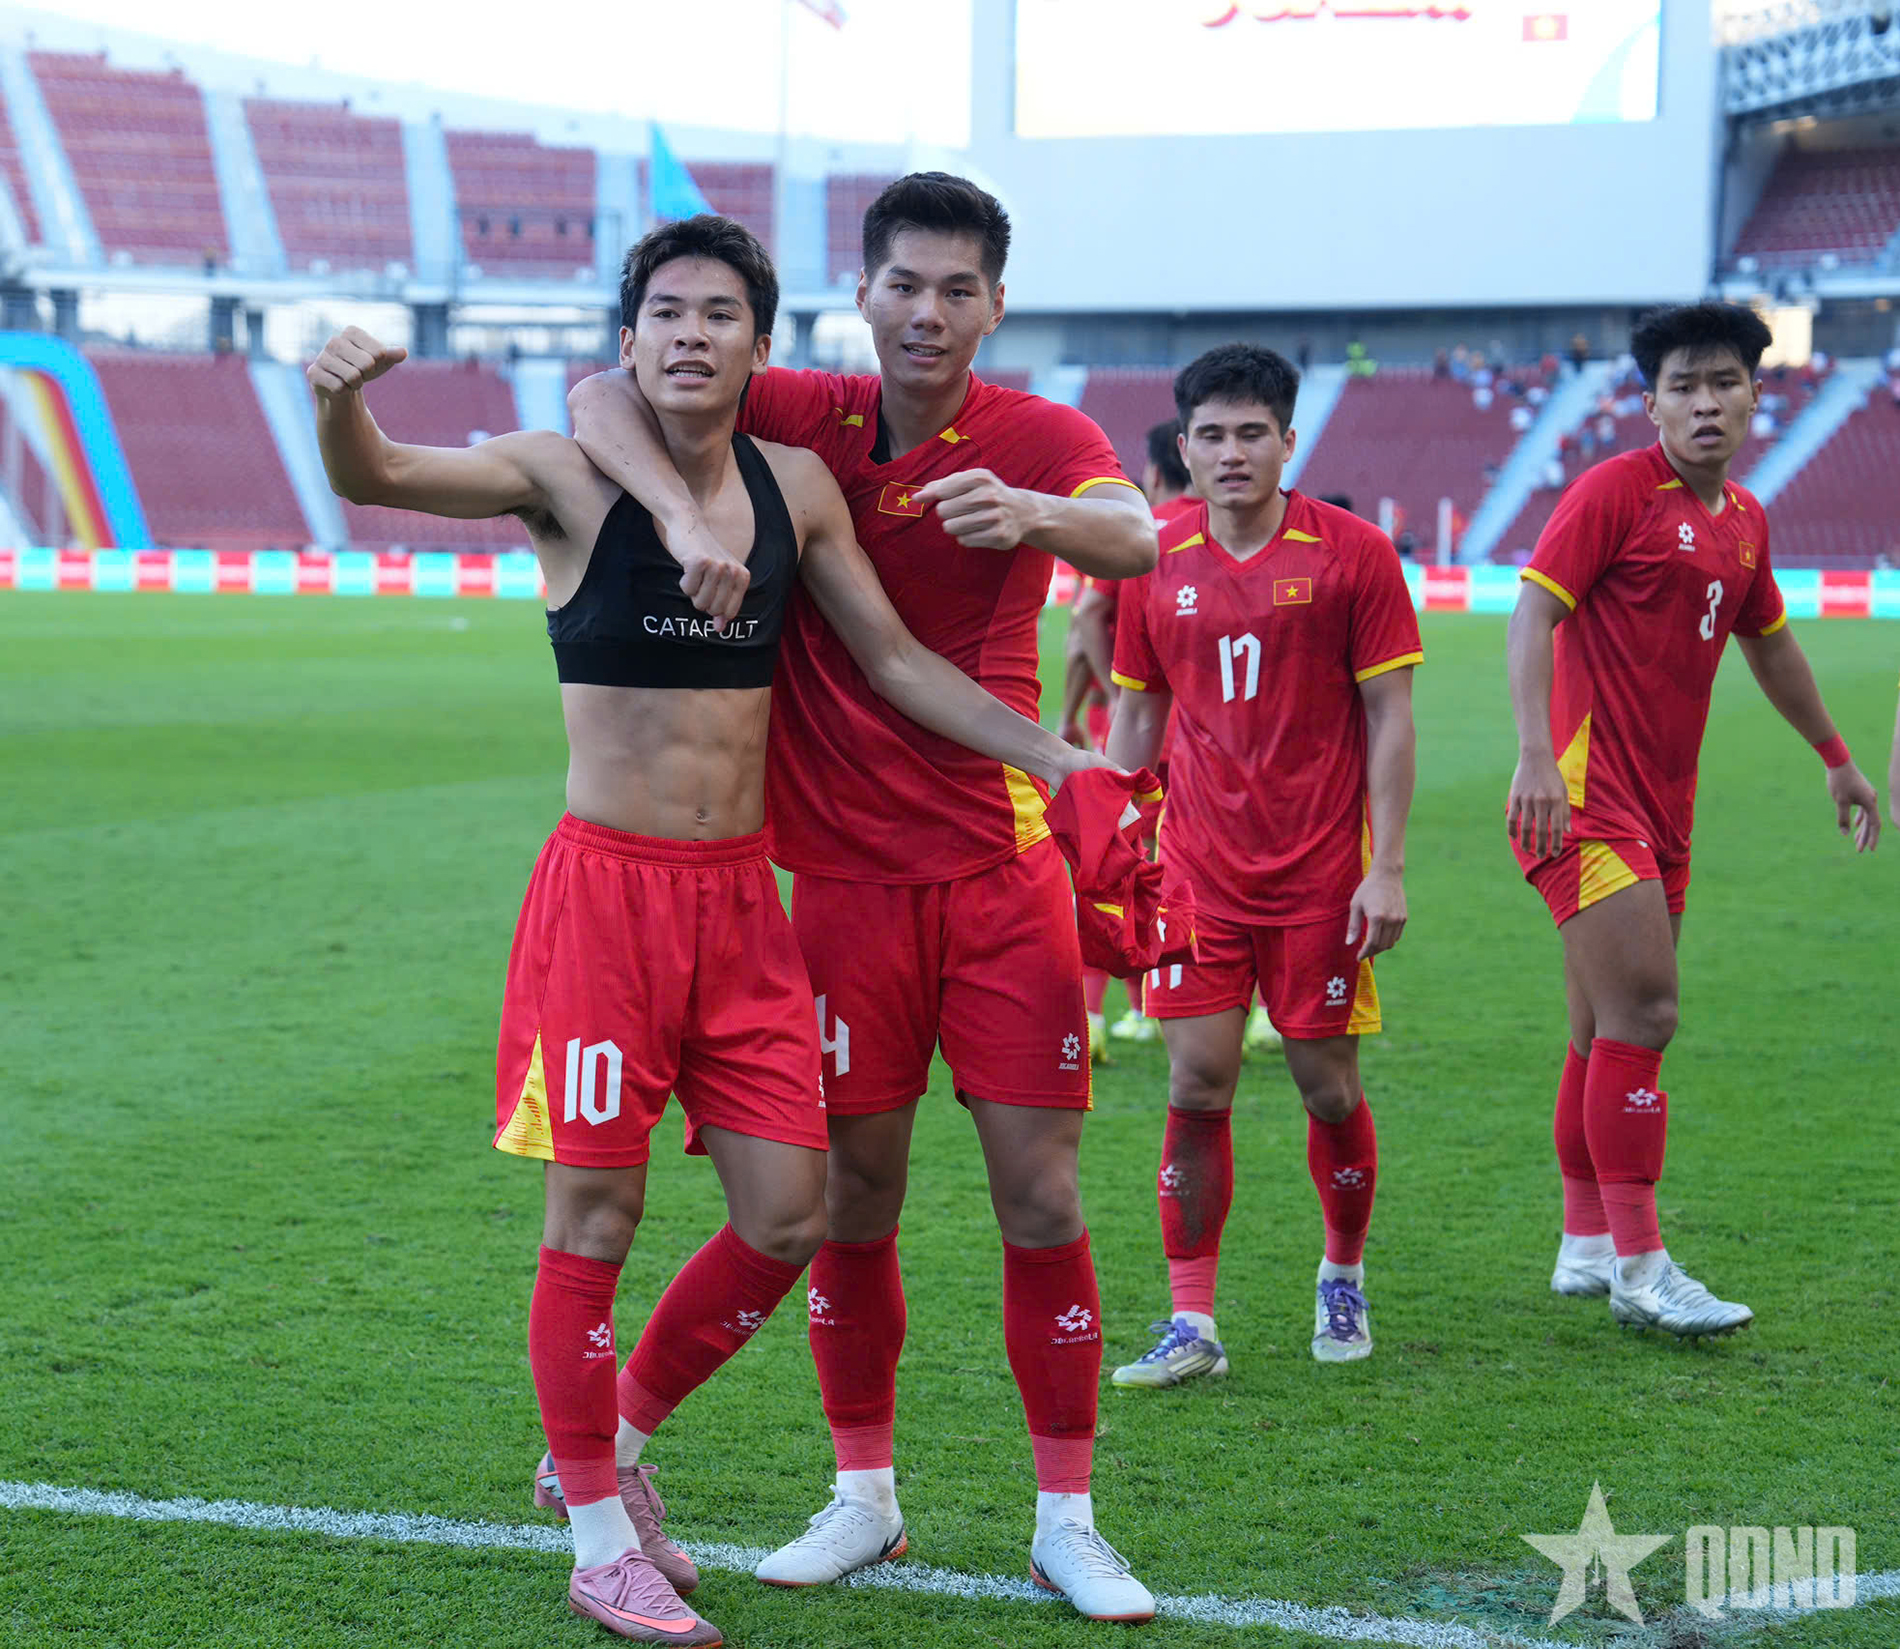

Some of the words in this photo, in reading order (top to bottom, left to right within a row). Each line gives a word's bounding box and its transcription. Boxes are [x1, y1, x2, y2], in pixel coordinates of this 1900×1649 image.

[643, 616, 758, 639] CATAPULT
[1699, 580, 1723, 641] 3
[1218, 632, 1261, 703] 17
[814, 993, 849, 1077] 4
[564, 1037, 623, 1126] 10
